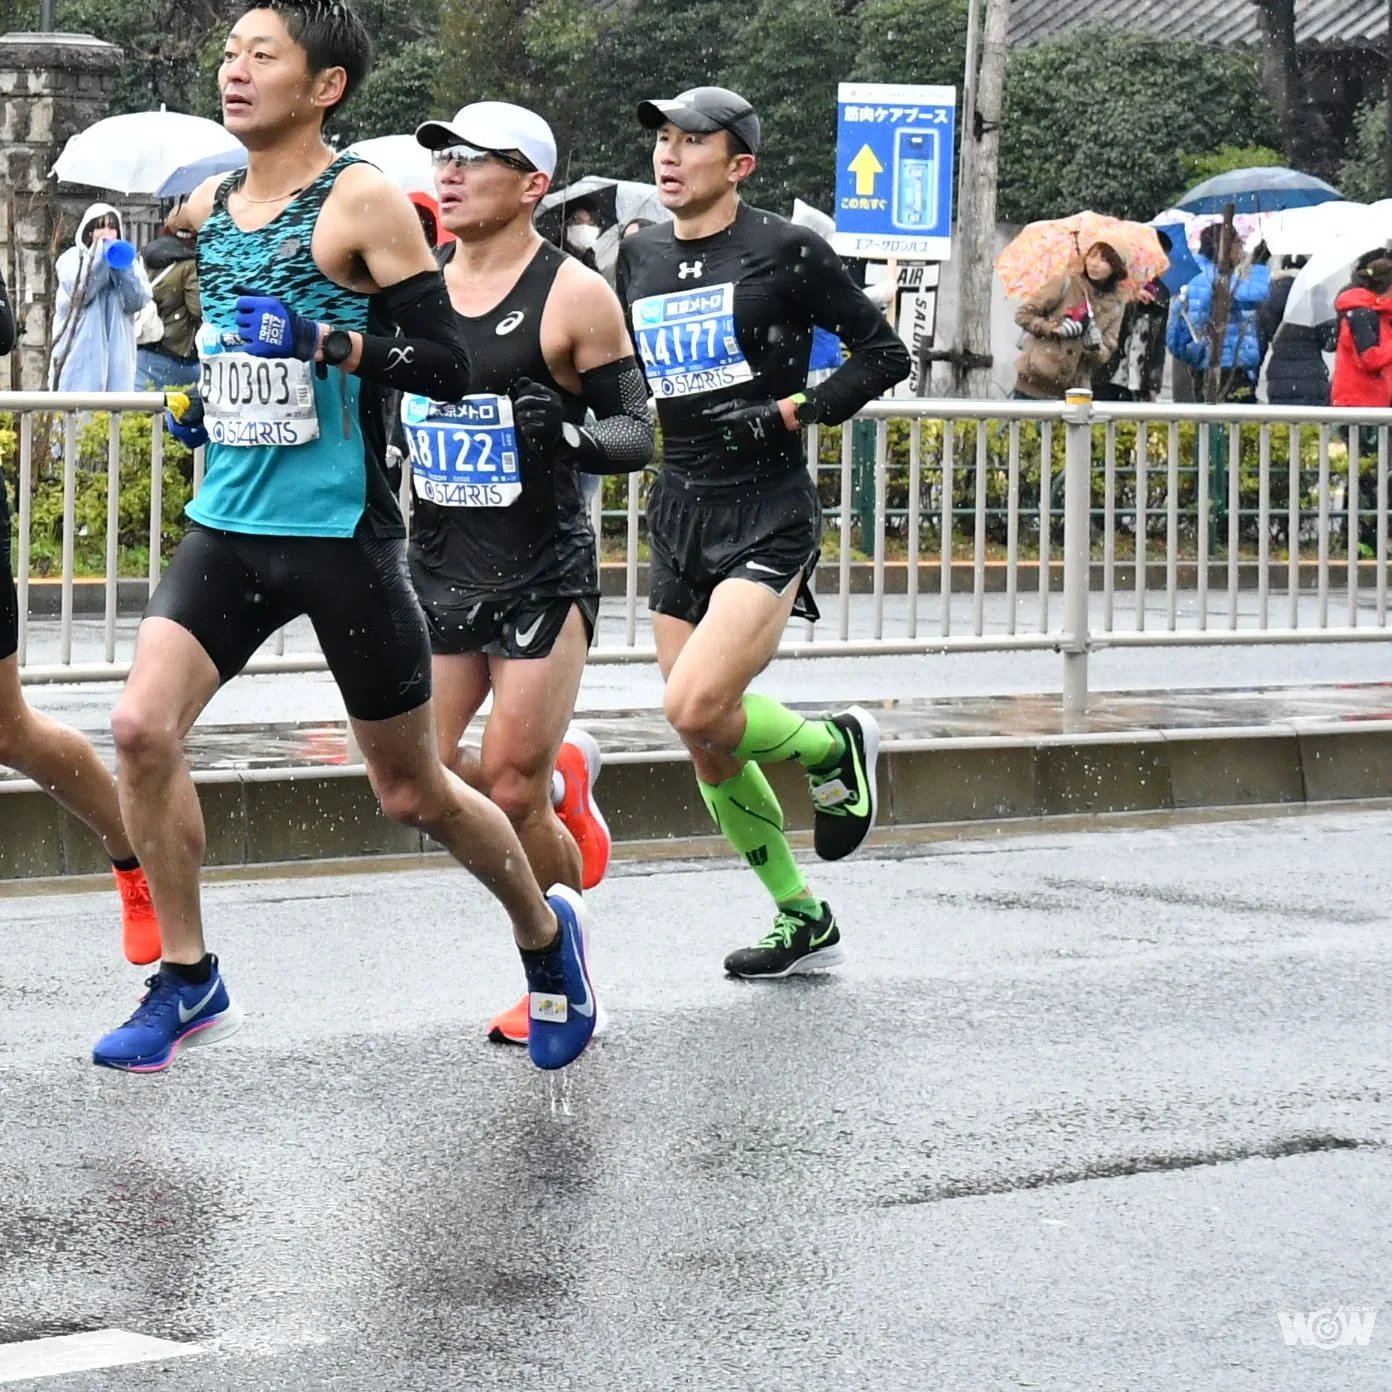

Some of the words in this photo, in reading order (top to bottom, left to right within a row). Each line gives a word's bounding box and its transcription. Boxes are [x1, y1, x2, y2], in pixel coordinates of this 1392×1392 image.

[844, 105, 949, 124] 筋肉ケアブース
[897, 267, 924, 285] AIR
[258, 312, 270, 341] TOKYO
[269, 315, 282, 345] 2017
[639, 319, 717, 368] A4177
[201, 361, 290, 406] B10303
[676, 367, 735, 394] STARTS
[227, 421, 298, 444] STARTS
[405, 427, 497, 472] A8122
[435, 484, 503, 505] STARTS
